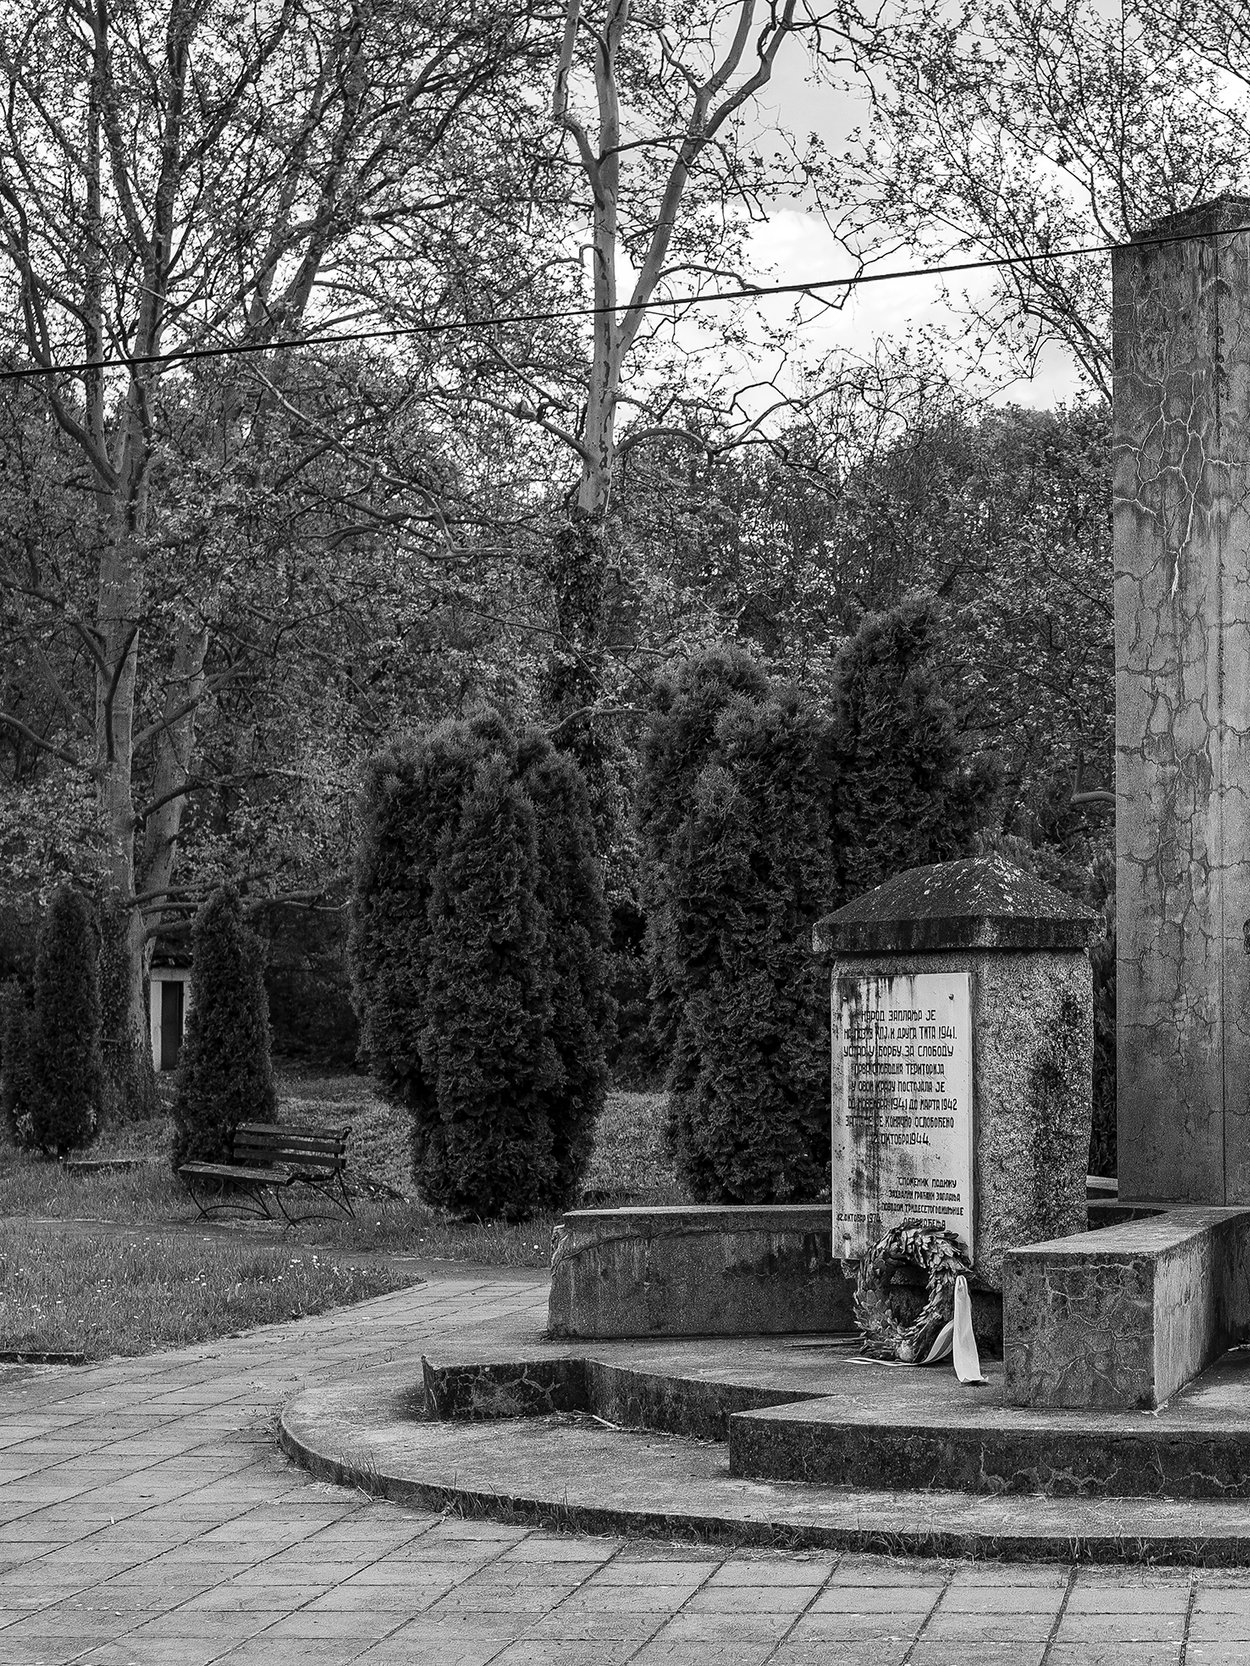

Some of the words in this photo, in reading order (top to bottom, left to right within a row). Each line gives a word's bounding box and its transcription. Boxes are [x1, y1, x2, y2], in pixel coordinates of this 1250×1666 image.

[862, 1010, 885, 1022] НАРОД
[889, 1010, 922, 1021] ЗАПЛАЊА
[926, 1010, 936, 1021] ЈЕ
[897, 1028, 917, 1040] ДРУГА
[919, 1026, 936, 1039] ТИТА
[939, 1026, 957, 1039] 1941.
[879, 1046, 902, 1057] БОРБУ
[905, 1046, 914, 1057] ЗА
[918, 1046, 954, 1057] СЛОБОДУ
[906, 1063, 944, 1075] ТЕРИТОРИЈА
[898, 1081, 932, 1092] ПОСТОЈАЛА
[935, 1081, 945, 1092] ЈЕ
[909, 1098, 918, 1110] ДО
[920, 1099, 940, 1110] МАРТА
[915, 1117, 954, 1128] ОСЛОБОЂЕНО
